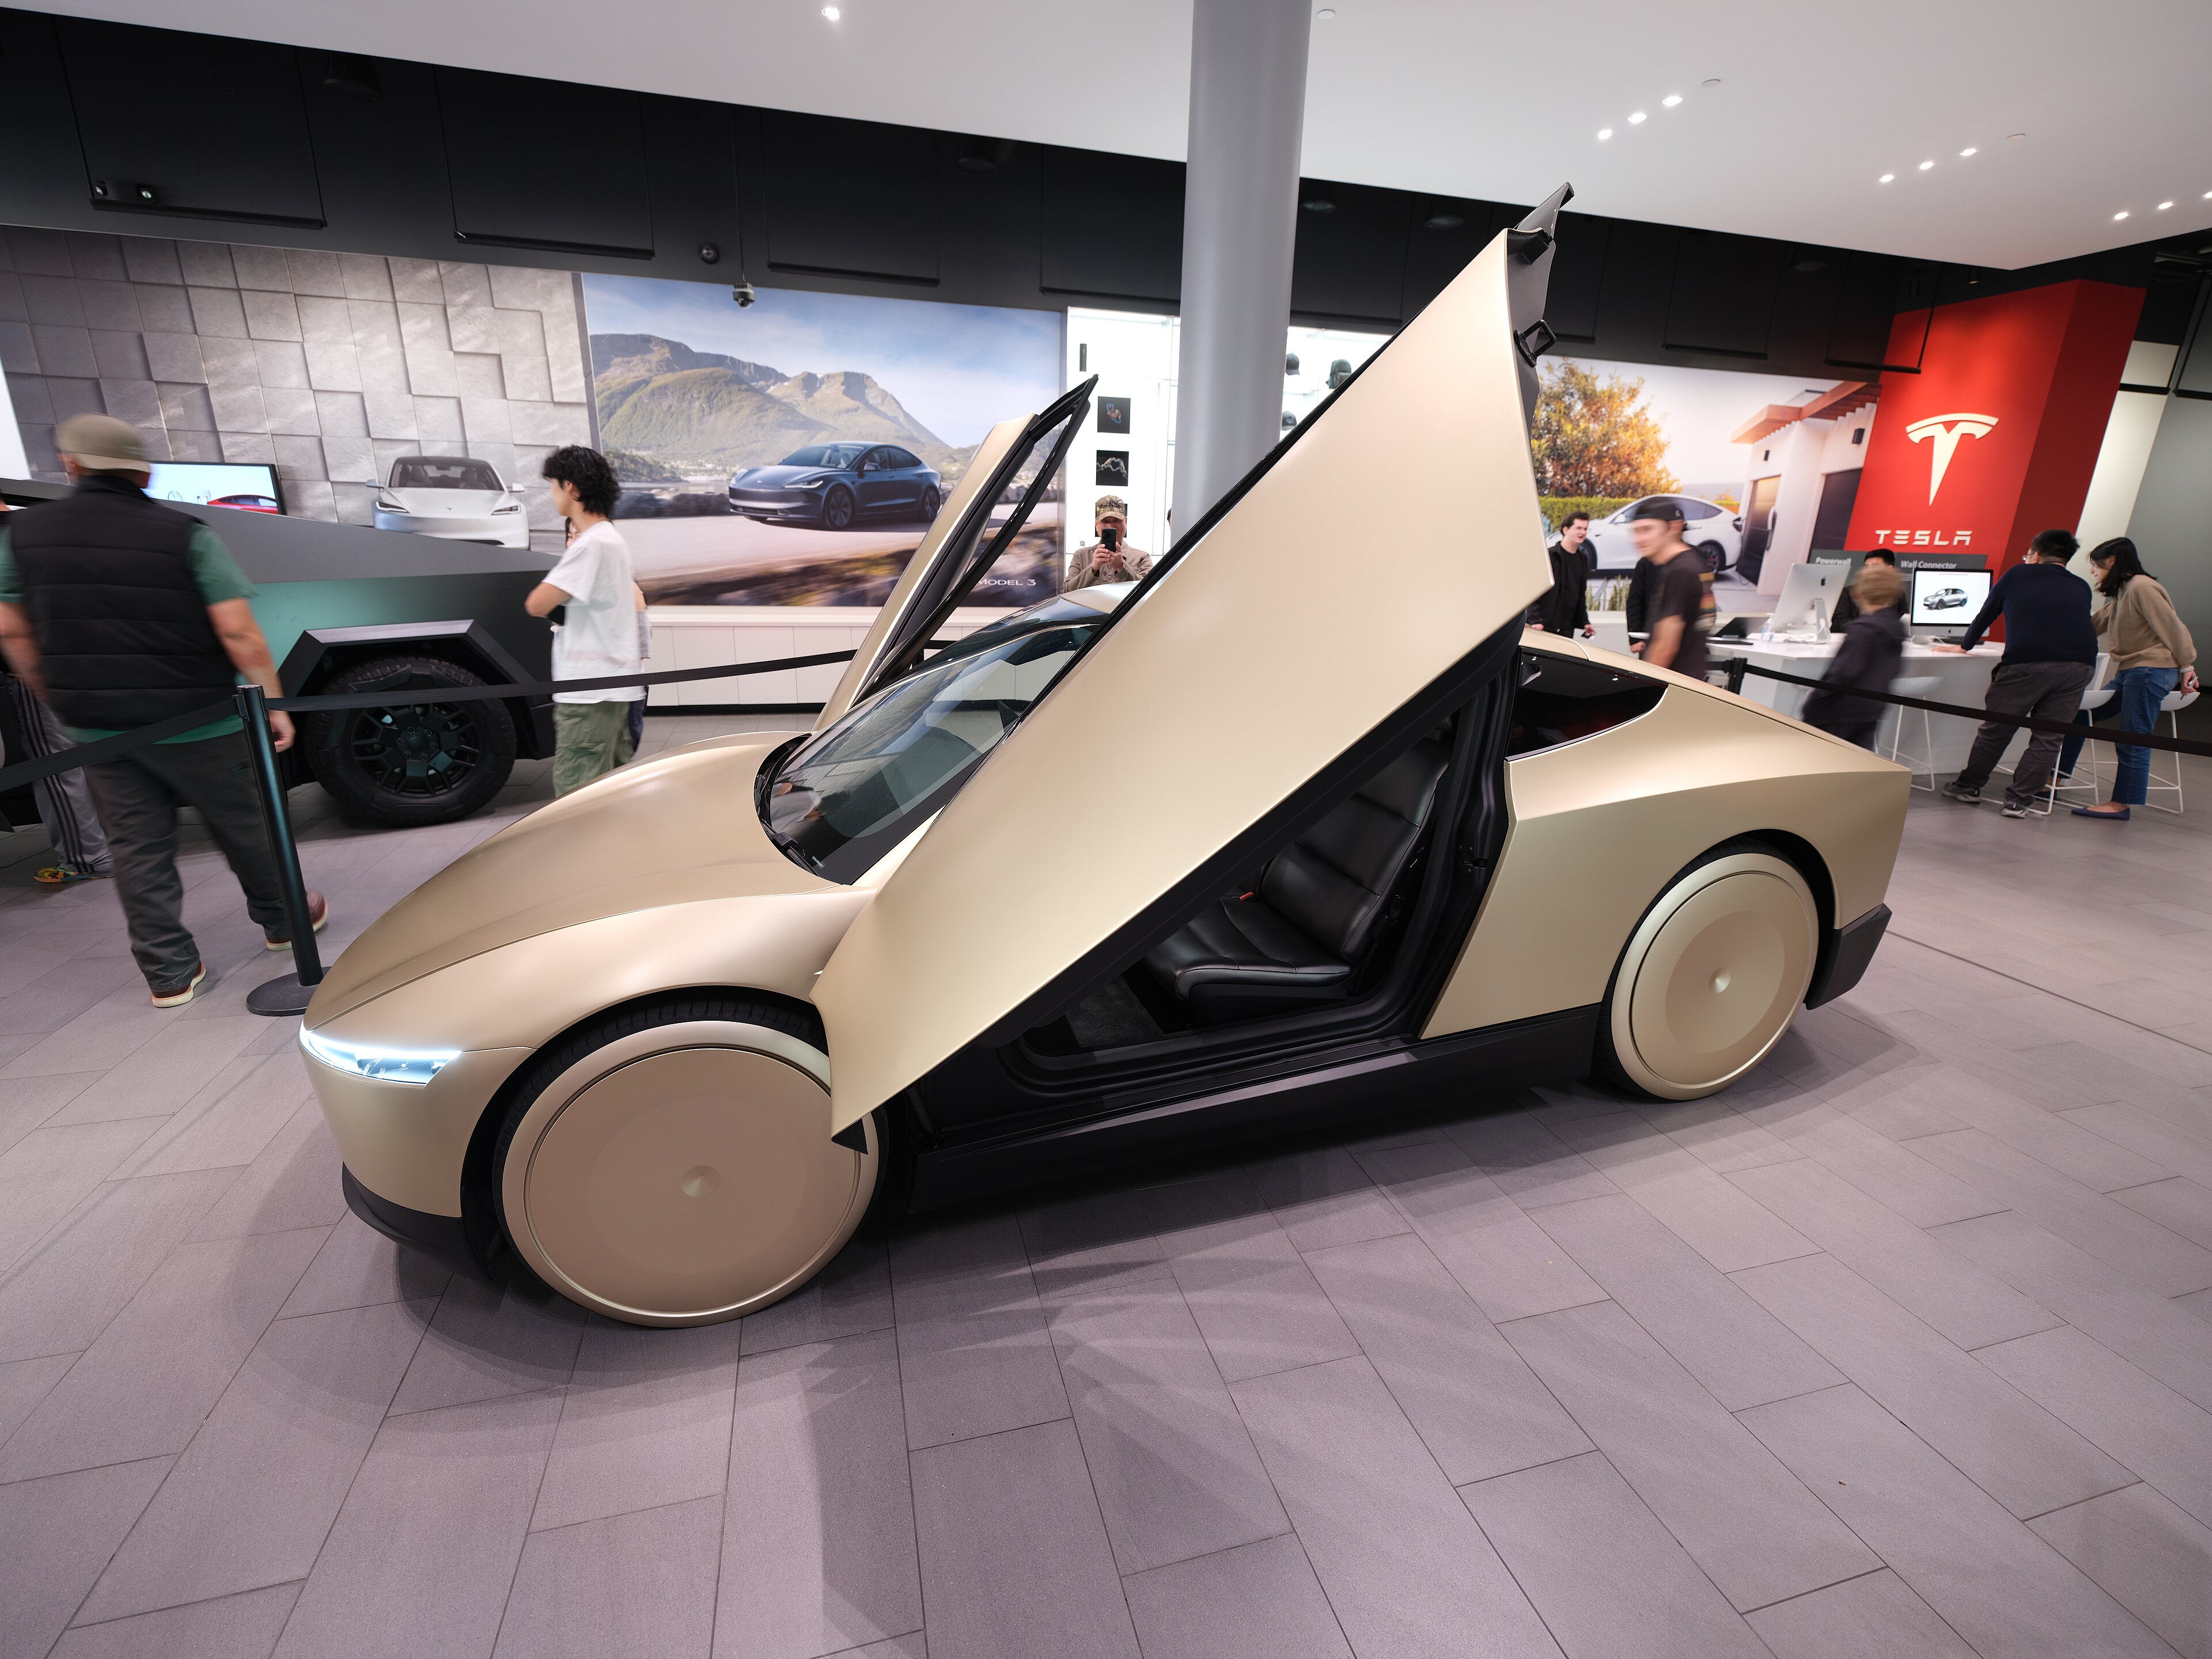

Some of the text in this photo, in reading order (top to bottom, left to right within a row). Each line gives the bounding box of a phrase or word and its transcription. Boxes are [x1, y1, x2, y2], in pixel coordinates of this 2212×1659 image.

[1875, 529, 1972, 546] TESLA
[1815, 556, 1851, 565] Powerwall
[1901, 560, 1957, 569] Wall Connector
